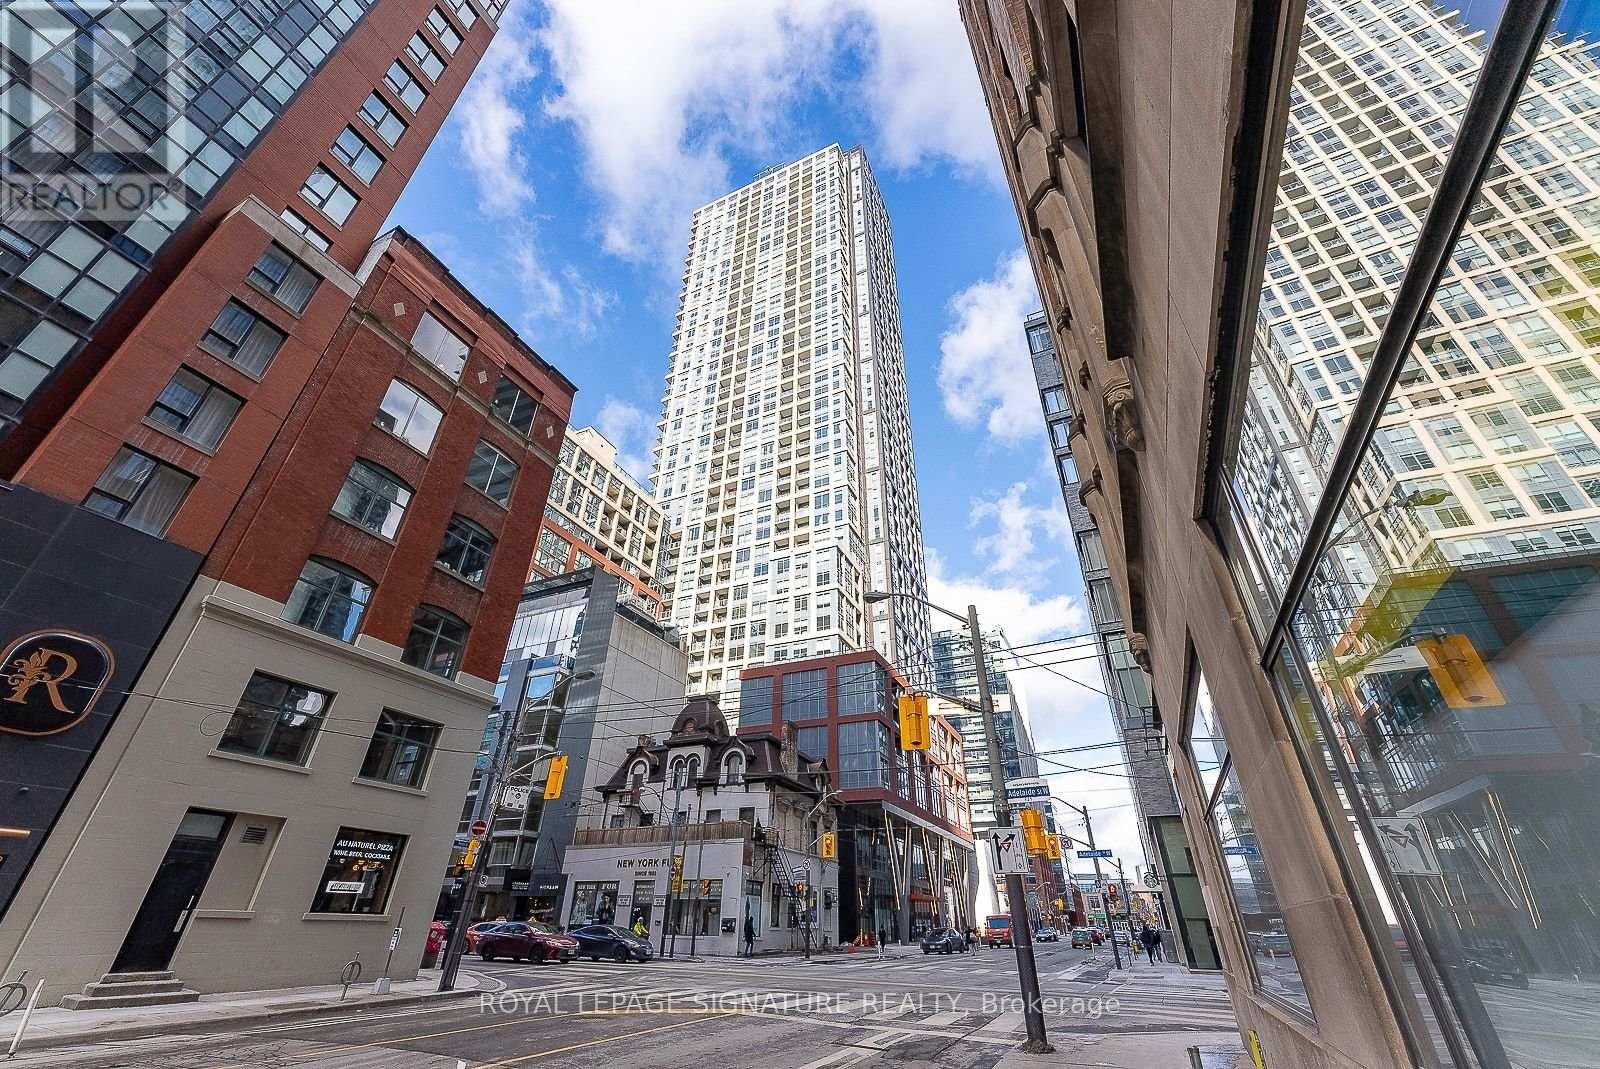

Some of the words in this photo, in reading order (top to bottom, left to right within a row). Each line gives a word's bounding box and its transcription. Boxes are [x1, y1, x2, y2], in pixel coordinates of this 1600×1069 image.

[1008, 788, 1036, 797] Adelaide
[347, 840, 376, 849] NATUREL
[377, 843, 394, 851] PIZZA
[617, 859, 635, 868] NEW
[637, 858, 660, 868] YORK
